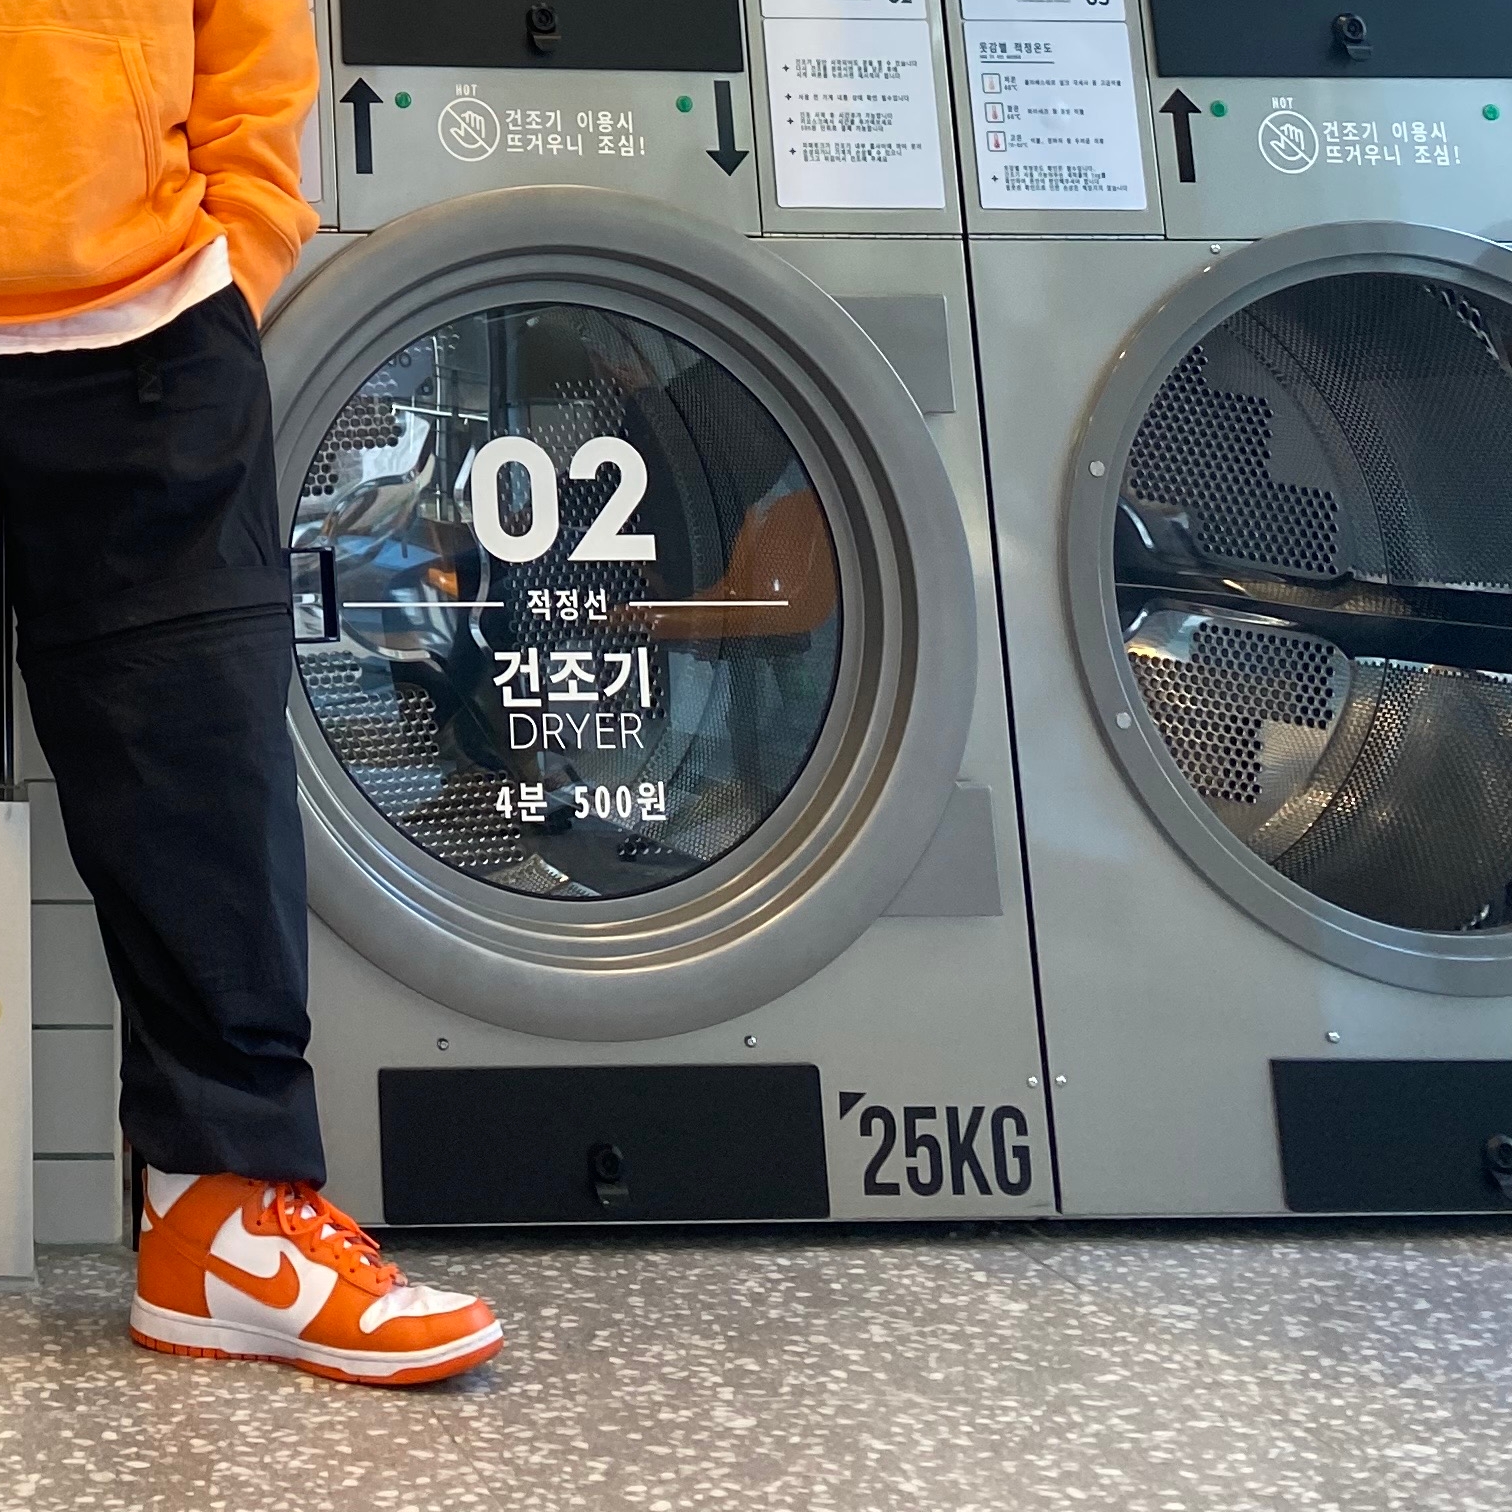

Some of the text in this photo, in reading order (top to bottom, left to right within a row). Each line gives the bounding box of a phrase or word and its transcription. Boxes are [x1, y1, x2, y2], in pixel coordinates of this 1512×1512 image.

[979, 42, 1052, 54] 옷감별 적정온도
[455, 85, 477, 96] HOT
[1272, 97, 1293, 109] HOT
[506, 110, 634, 132] 건조기 이용시
[1323, 122, 1447, 143] 건조기 이용시
[507, 134, 646, 157] 뜨거우니 조심!
[1327, 144, 1461, 166] 뜨거우니 조심!
[470, 436, 655, 563] 02
[527, 590, 608, 621] 적정선
[493, 648, 650, 707] 건조기
[509, 713, 644, 749] DRYER
[495, 781, 665, 822] 4분 500원
[859, 1105, 1032, 1196] 25KG
